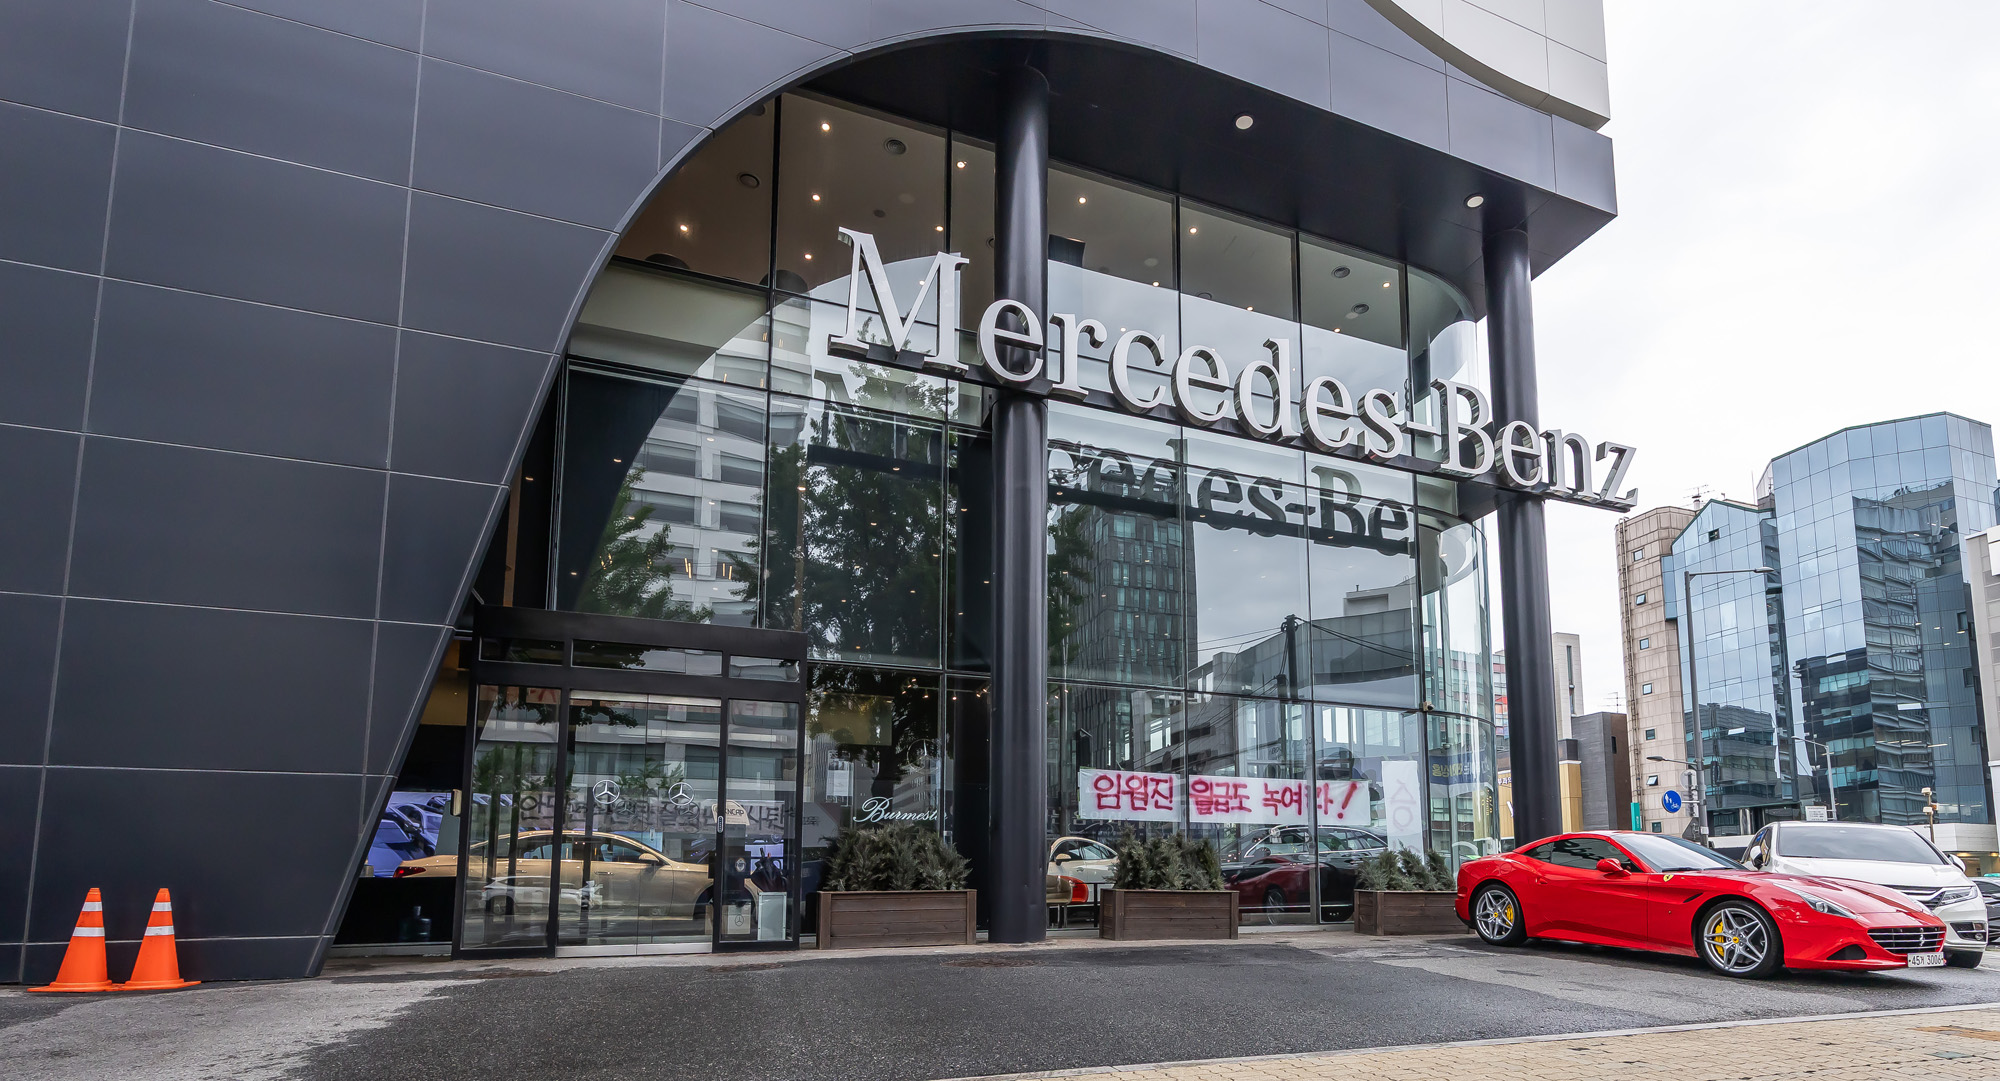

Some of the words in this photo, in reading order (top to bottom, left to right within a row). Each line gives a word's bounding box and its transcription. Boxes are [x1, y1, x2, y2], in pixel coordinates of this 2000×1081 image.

[827, 226, 1638, 508] Mercedes-Benz
[1093, 773, 1174, 811] 임원진
[1189, 780, 1252, 816] 월급도
